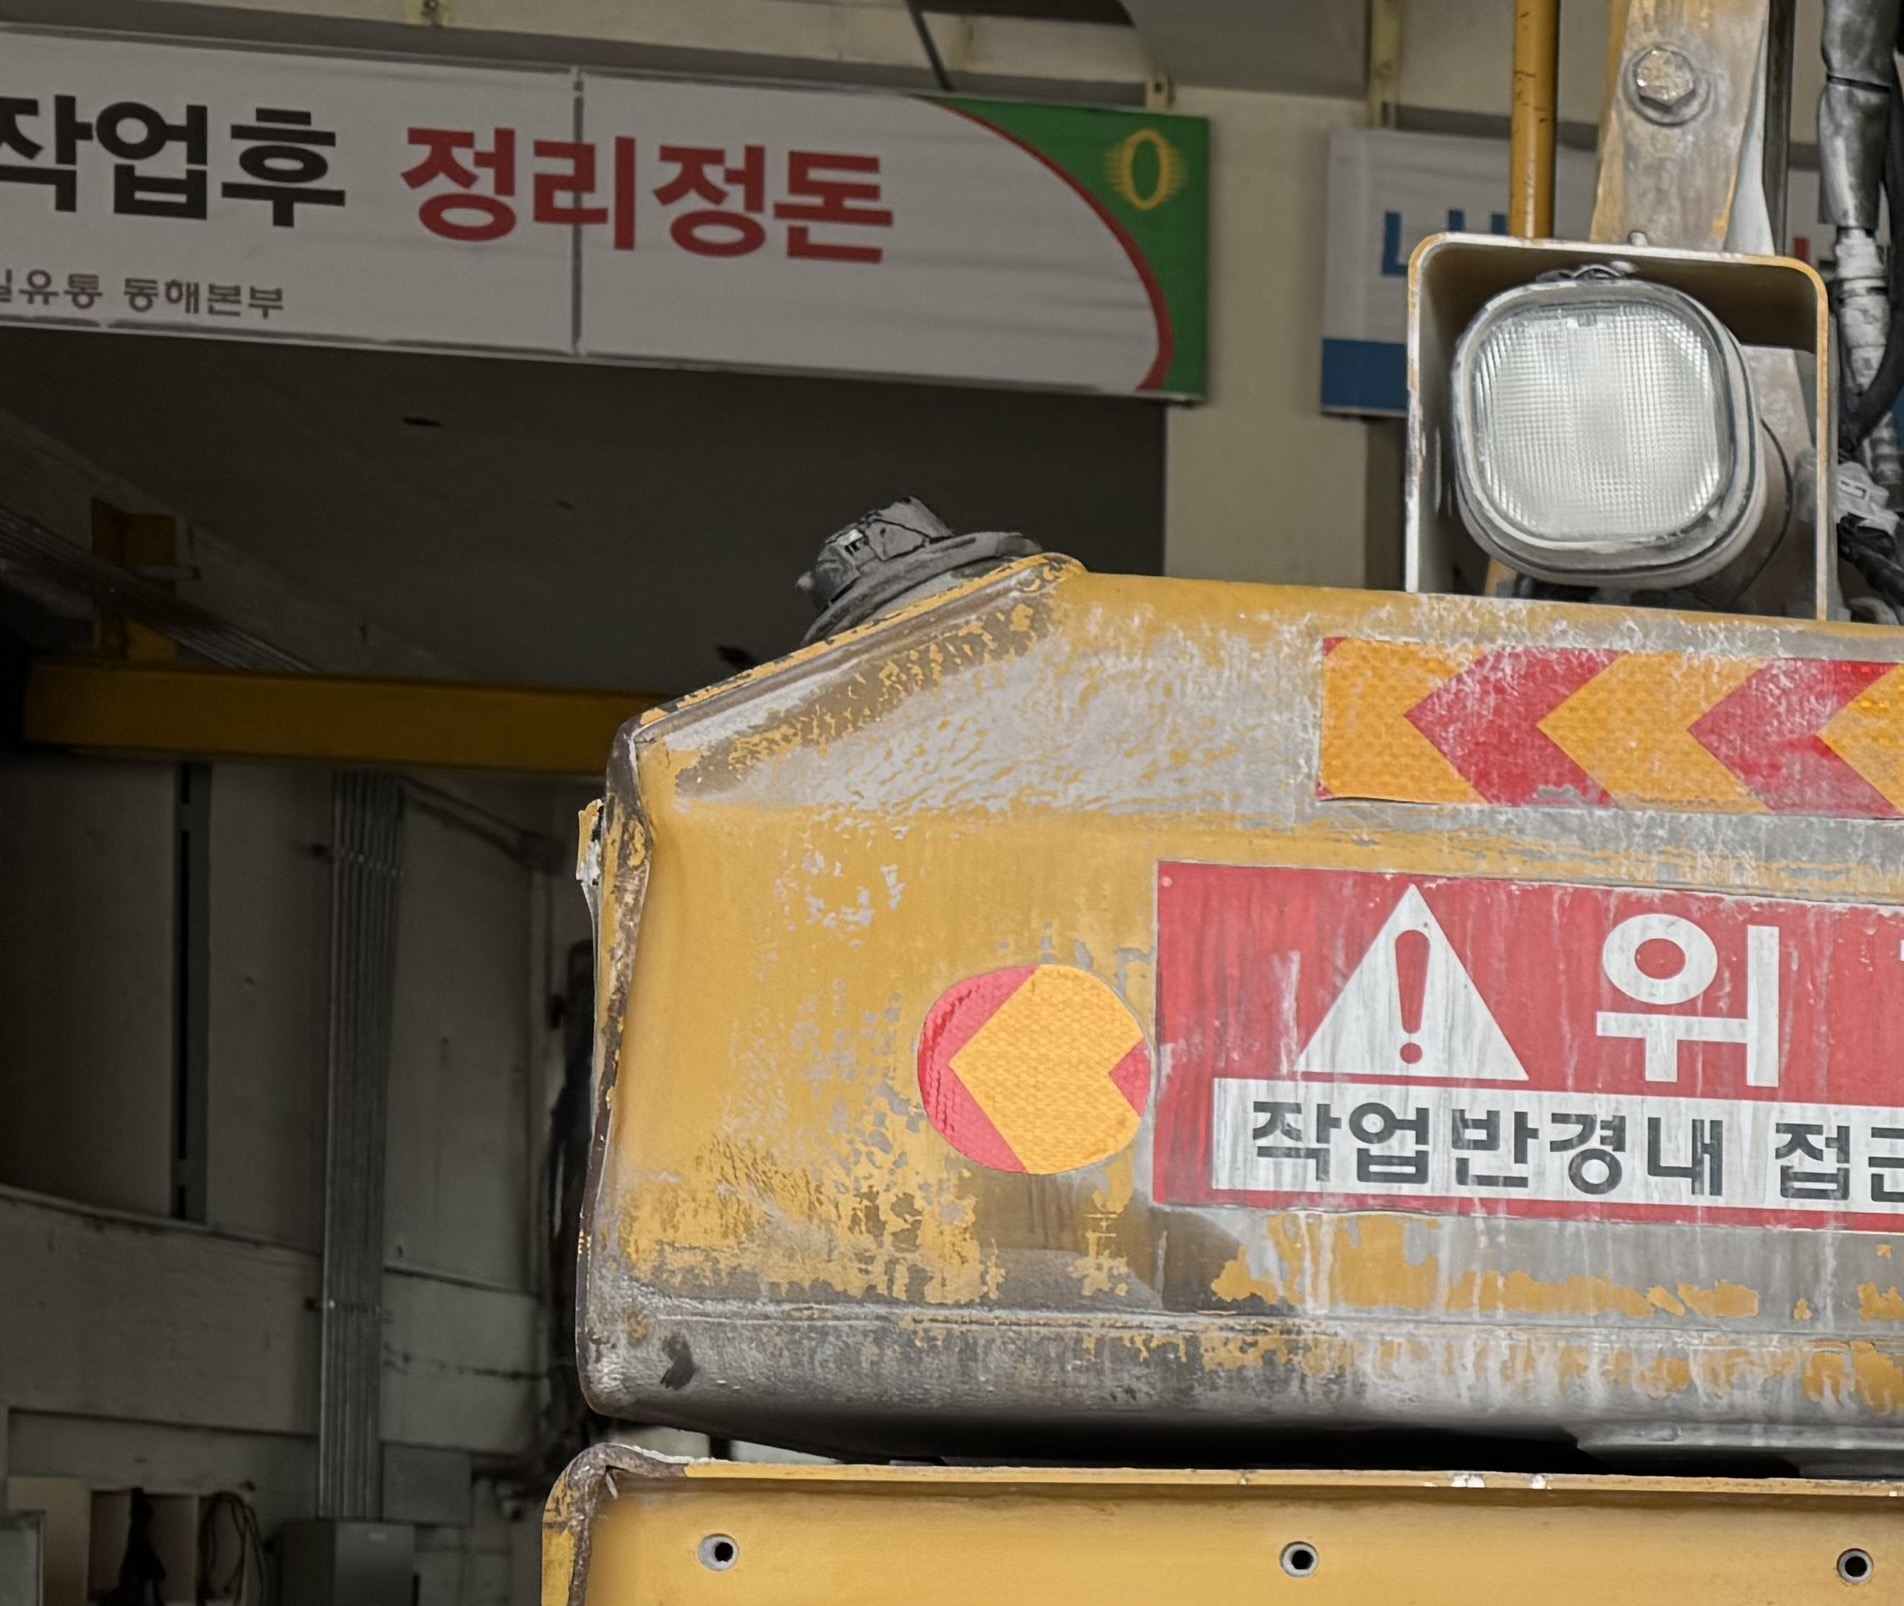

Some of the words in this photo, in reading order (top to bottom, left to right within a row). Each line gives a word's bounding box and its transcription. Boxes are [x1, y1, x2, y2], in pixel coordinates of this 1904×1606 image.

[0, 95, 345, 227] 작업후
[403, 127, 893, 263] 정리정돈
[123, 277, 284, 319] 동해본부
[1251, 1100, 1724, 1197] 작업반경내
